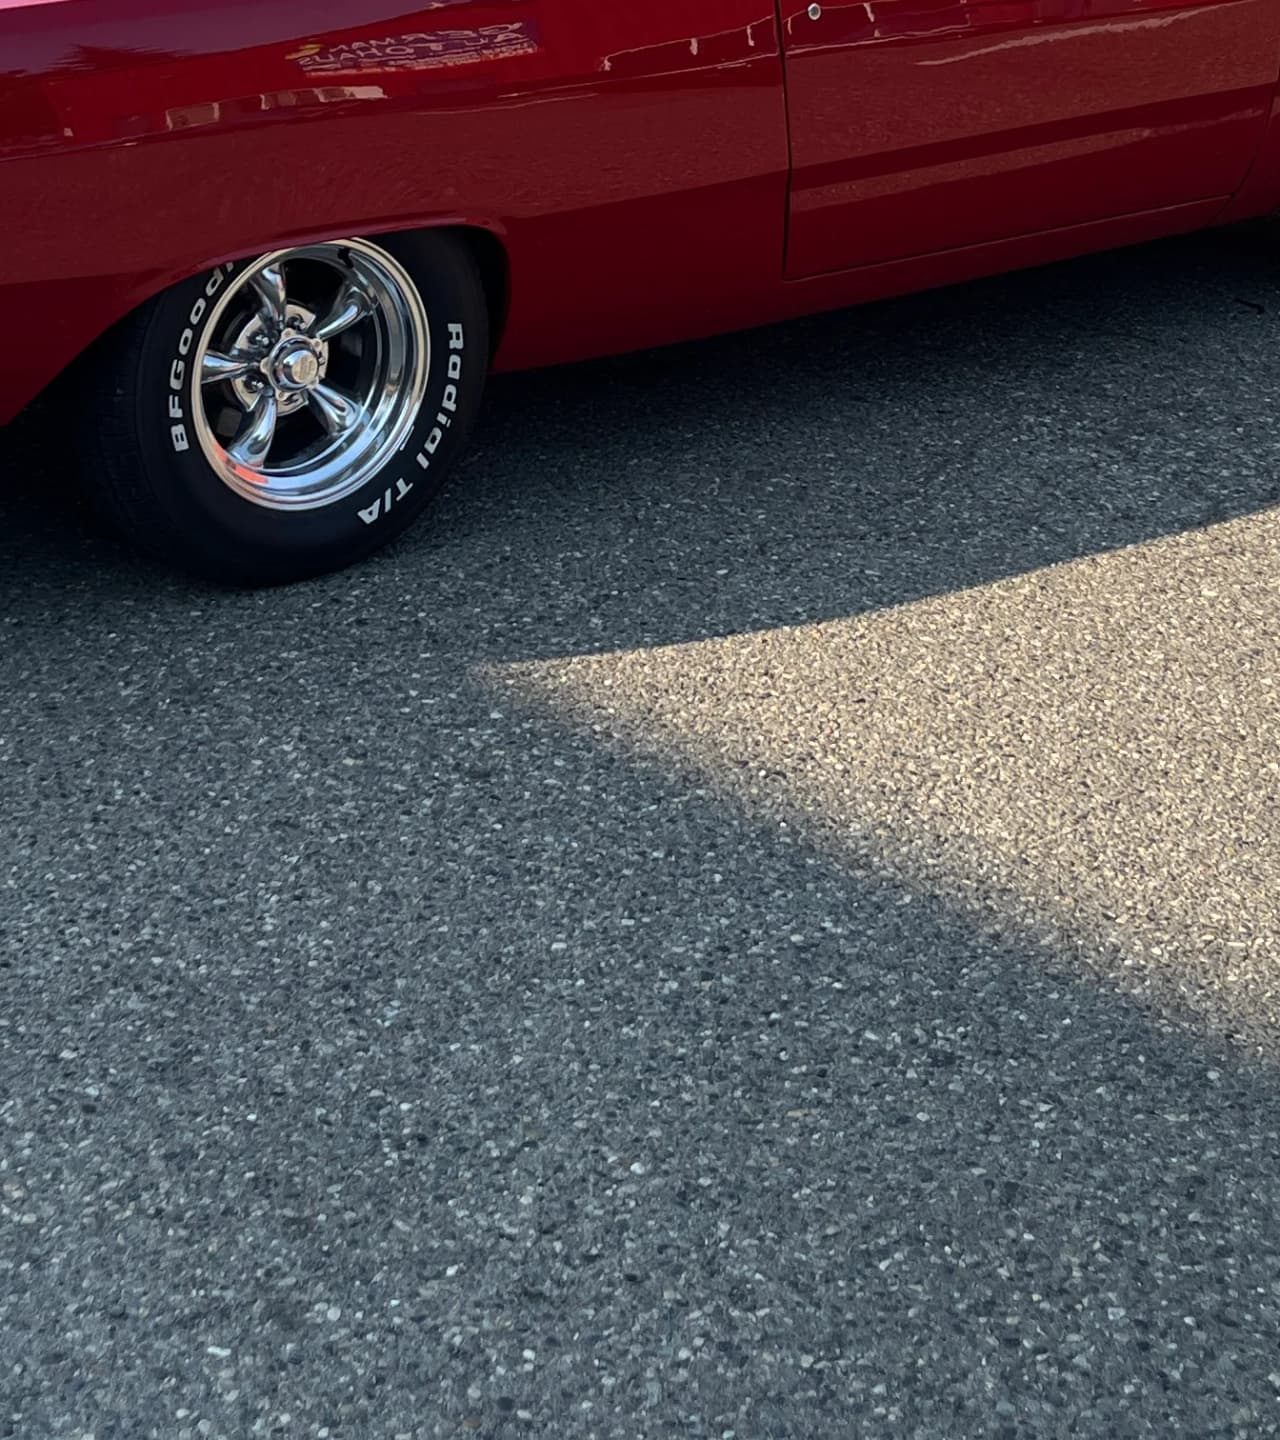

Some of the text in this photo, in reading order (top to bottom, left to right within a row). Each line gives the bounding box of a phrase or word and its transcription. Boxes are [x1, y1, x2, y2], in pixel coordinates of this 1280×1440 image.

[168, 260, 235, 452] BFGood
[357, 323, 465, 525] Radial T/A
